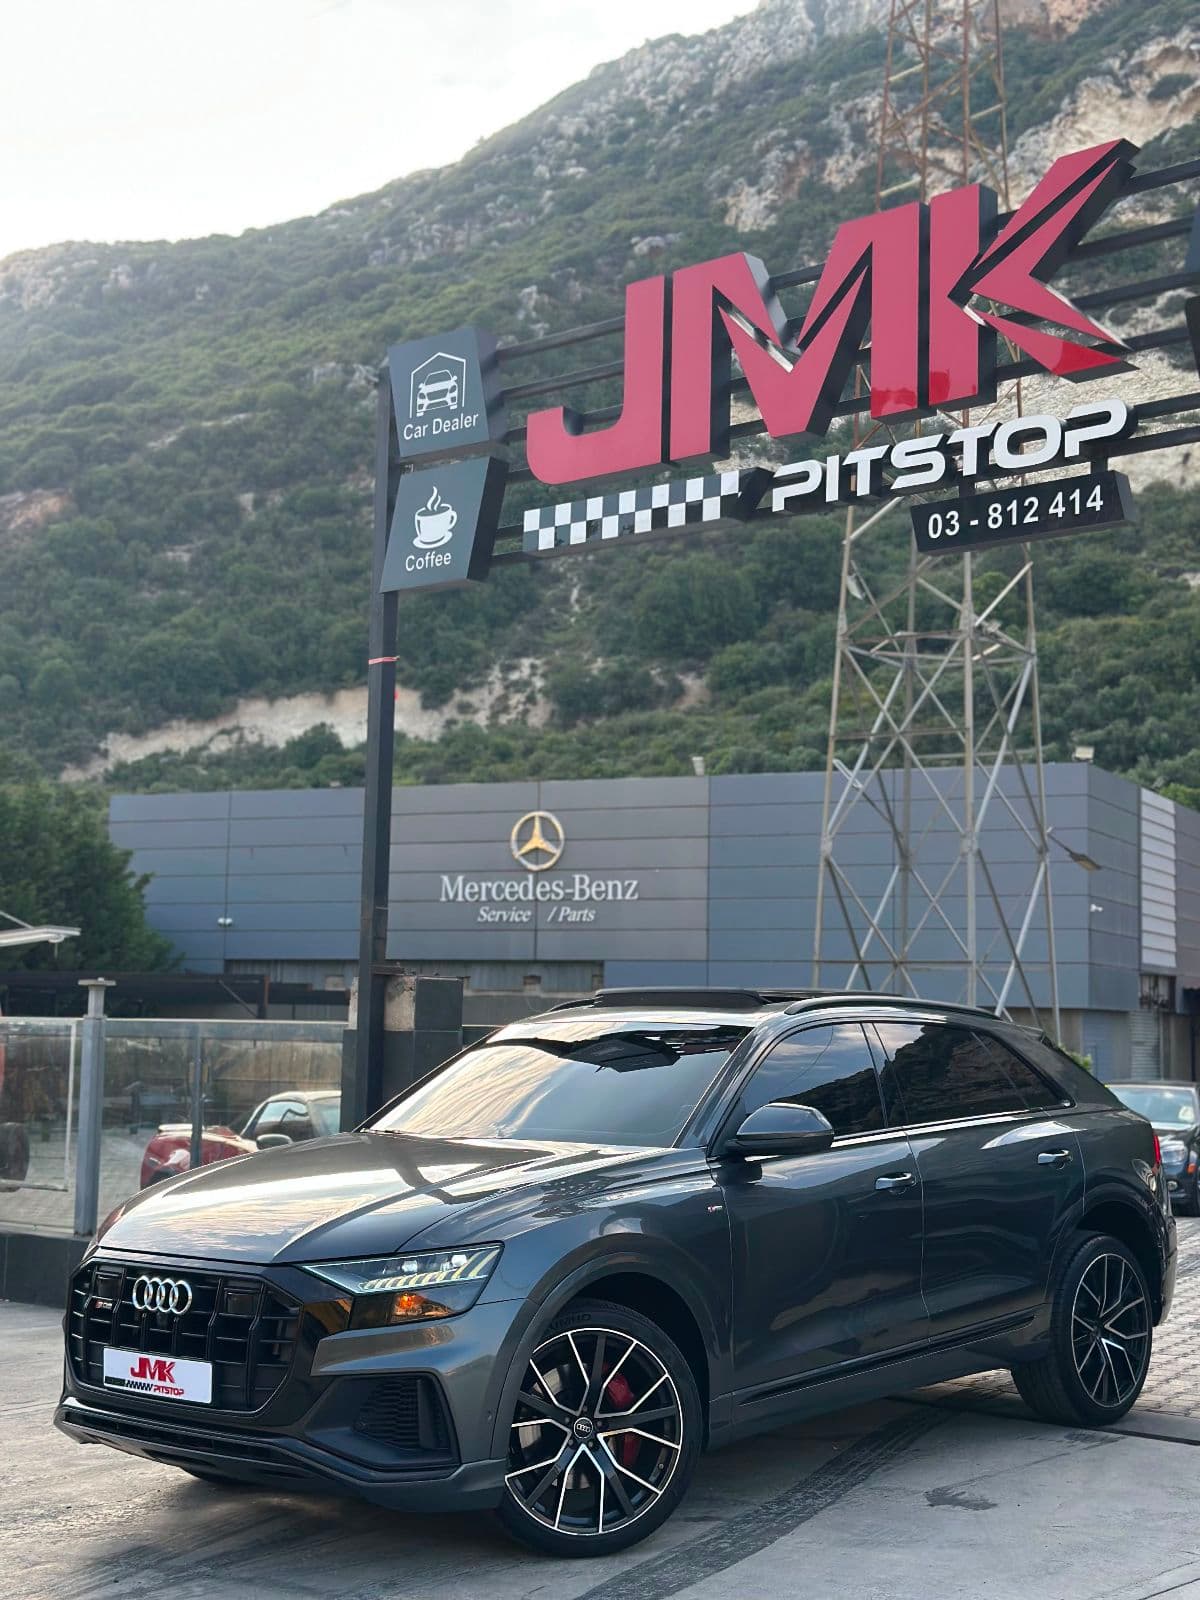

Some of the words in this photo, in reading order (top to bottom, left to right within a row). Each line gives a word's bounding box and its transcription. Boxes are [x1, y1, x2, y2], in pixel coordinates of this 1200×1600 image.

[526, 137, 1134, 485] JMK
[403, 422, 428, 440] Car
[432, 413, 479, 435] Dealer
[772, 400, 1127, 511] PITSTOP
[928, 511, 961, 541] 03
[986, 496, 1040, 530] 812
[1048, 484, 1104, 519] 414
[405, 551, 452, 572] Coffee
[440, 874, 639, 902] Mercedes-Benz
[477, 906, 531, 922] Service
[558, 906, 596, 922] Parts
[130, 1357, 176, 1384] JMK
[153, 1384, 185, 1396] PITSTOP
